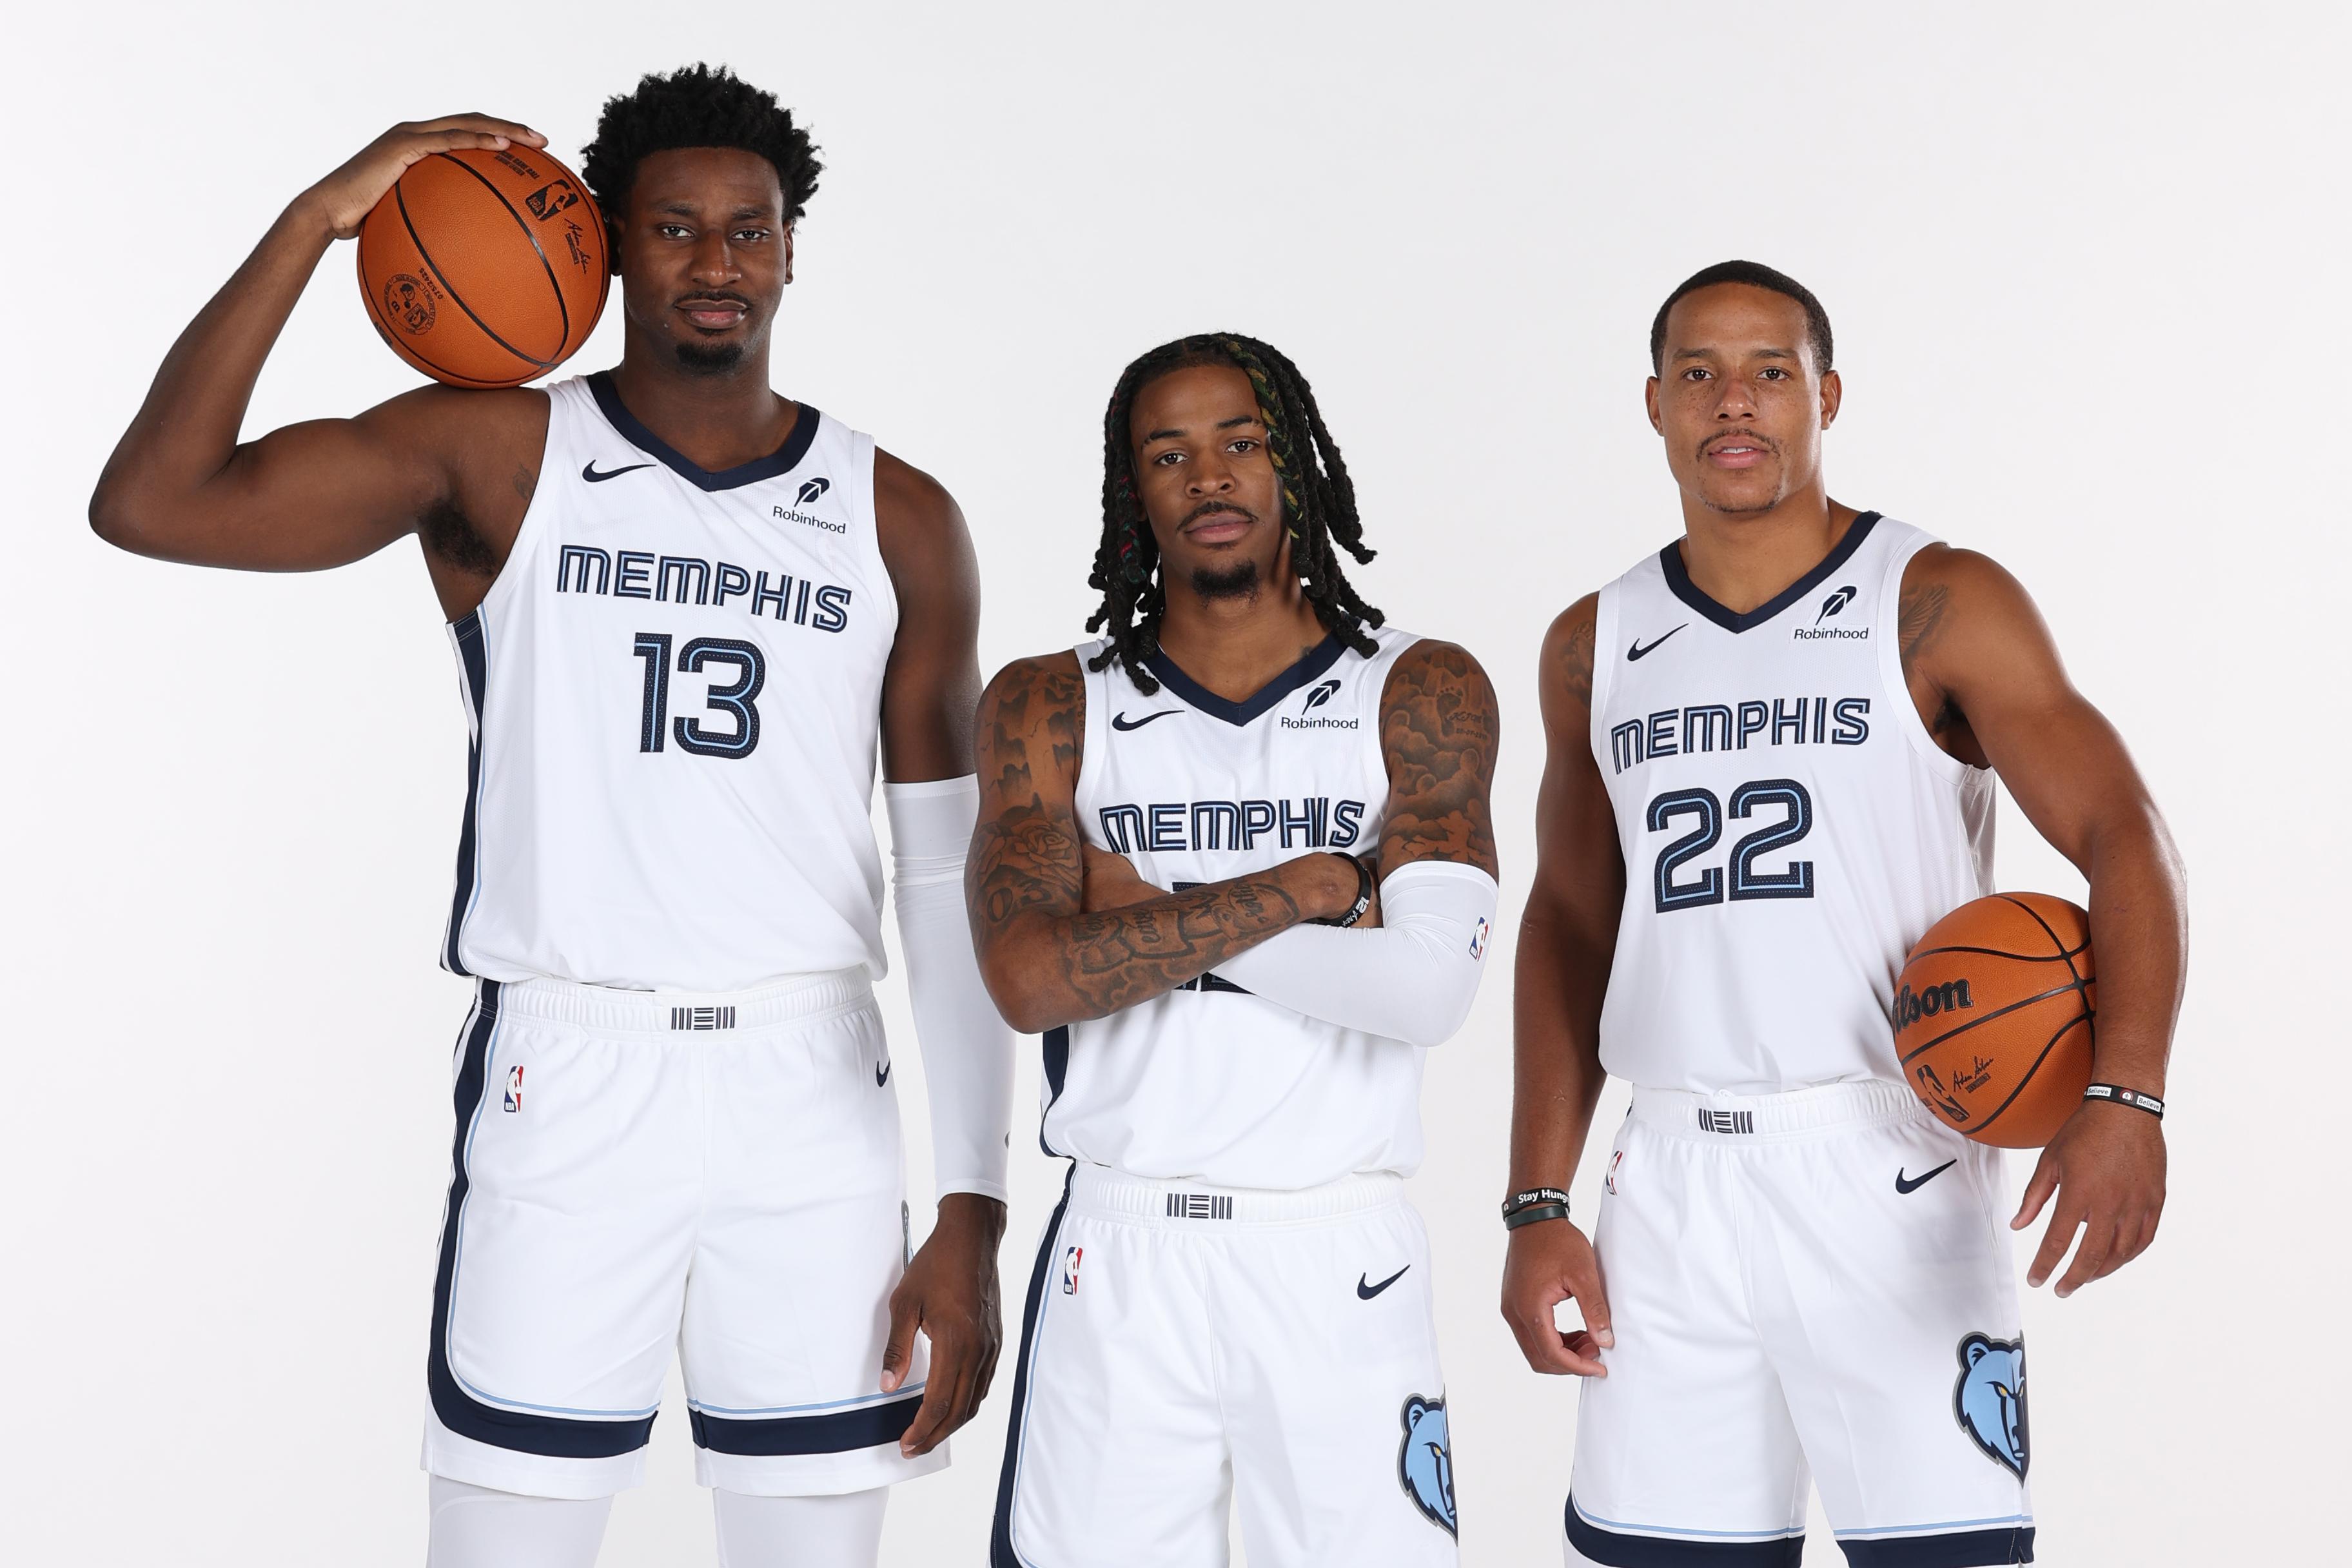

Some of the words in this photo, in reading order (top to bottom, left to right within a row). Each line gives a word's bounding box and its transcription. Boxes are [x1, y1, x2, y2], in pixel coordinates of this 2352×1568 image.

[773, 505, 846, 534] Robinhood
[556, 544, 852, 633] MEMPHIS
[1794, 627, 1868, 640] Robinhood
[633, 632, 766, 760] 13
[1280, 717, 1358, 730] Robinhood
[1611, 697, 1870, 775] MEMPHIS
[1099, 796, 1366, 854] MEMPHIS
[1646, 778, 1814, 914] 22
[2088, 1087, 2109, 1095] Believe
[2138, 1097, 2160, 1110] Believe
[1518, 1191, 1539, 1204] Stay
